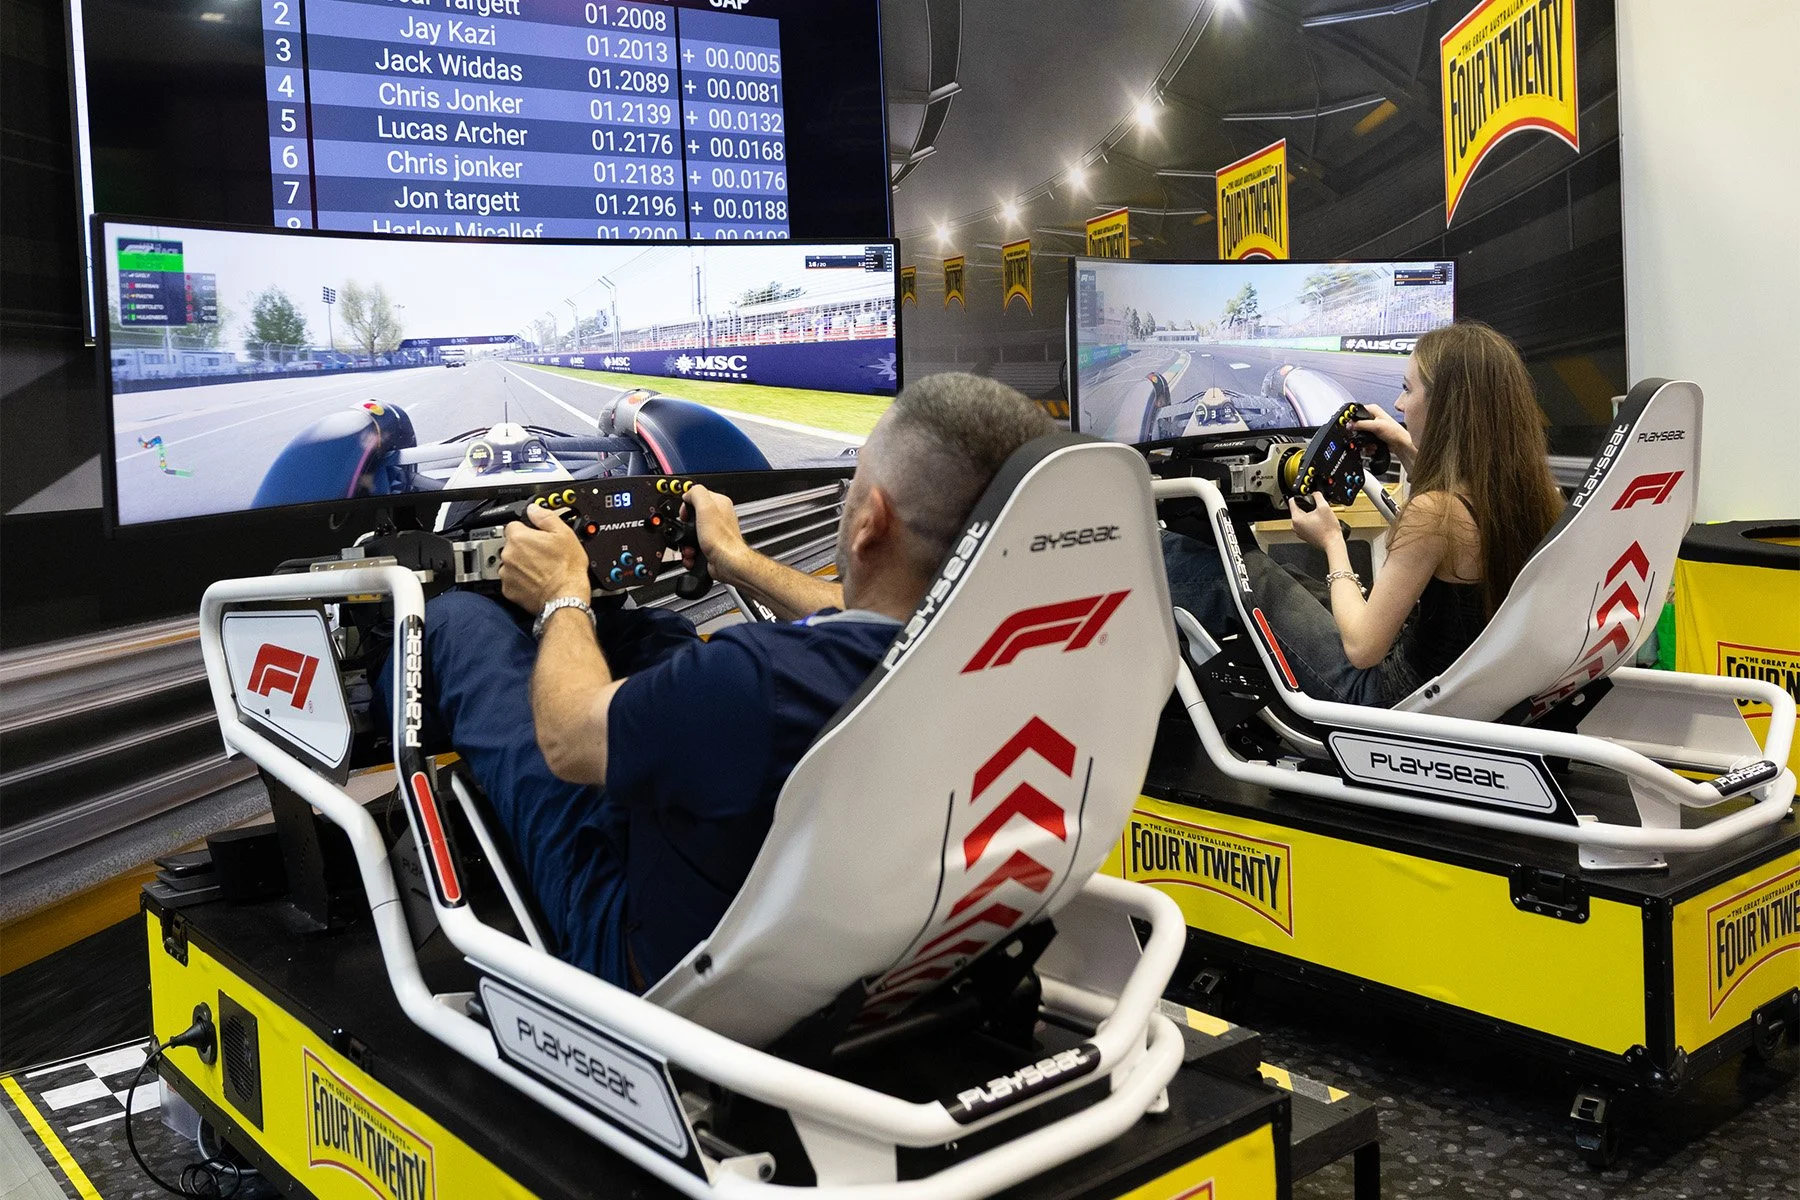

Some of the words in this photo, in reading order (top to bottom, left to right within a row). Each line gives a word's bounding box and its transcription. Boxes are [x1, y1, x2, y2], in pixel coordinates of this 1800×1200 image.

[273, 1, 291, 26] 2
[585, 3, 667, 31] 01.2008
[400, 16, 441, 45] Jay
[448, 20, 497, 46] Kazi
[1473, 26, 1488, 47] GREAT
[275, 38, 292, 61] 3
[587, 35, 668, 62] 01.2013
[683, 49, 695, 63] +
[705, 48, 780, 73] 00.0005
[375, 48, 433, 74] Jack
[438, 53, 523, 82] Widdas
[277, 75, 295, 98] 4
[588, 67, 670, 93] 01.2089
[685, 80, 697, 94] +
[707, 78, 778, 103] 00.0081
[1450, 36, 1500, 177] FOUR'N
[1500, 0, 1564, 103] TWENTY
[379, 82, 440, 109] Chris
[447, 89, 524, 115] Jonker
[281, 109, 297, 132] 5
[590, 99, 672, 125] 01.2139
[686, 111, 698, 124] +
[709, 108, 783, 133] 00.0132
[378, 115, 448, 141] Lucas
[455, 121, 528, 146] Archer
[592, 130, 673, 155] 01.2176
[282, 146, 299, 169] 6
[688, 140, 700, 154] +
[710, 137, 784, 161] 00.0168
[387, 150, 448, 175] Chris
[454, 154, 523, 181] jonker
[593, 161, 675, 186] 01.2183
[689, 171, 701, 185] +
[712, 168, 785, 190] 00.0176
[283, 181, 300, 204] 7
[394, 186, 439, 209] Jon
[445, 189, 520, 215] targett
[595, 193, 677, 216] 01.2196
[691, 201, 703, 215] +
[713, 198, 787, 220] 00.0188
[372, 219, 448, 236] Harley
[455, 221, 544, 238] Micallef
[597, 225, 678, 239] 012200
[715, 229, 788, 239] 0001
[611, 356, 630, 366] MSC
[694, 355, 747, 371] MSC
[502, 450, 512, 463] 3
[600, 519, 645, 531] FANATEC
[1745, 656, 1758, 664] THE
[1761, 659, 1787, 667] GREAT
[1149, 823, 1162, 831] THE
[1164, 827, 1185, 837] GREAT
[1187, 833, 1231, 848] AUSTRALIAN
[1233, 843, 1256, 854] TASTE
[1131, 821, 1198, 873] FOUR'N
[1199, 844, 1281, 911] TWENTY
[1732, 907, 1742, 917] THE
[1743, 898, 1760, 912] GREAT
[1762, 882, 1794, 903] AUSTRALIAN
[1716, 904, 1770, 990] FOUR'N
[312, 1072, 364, 1163] FOUR'N
[363, 1121, 426, 1200] TWENTY
